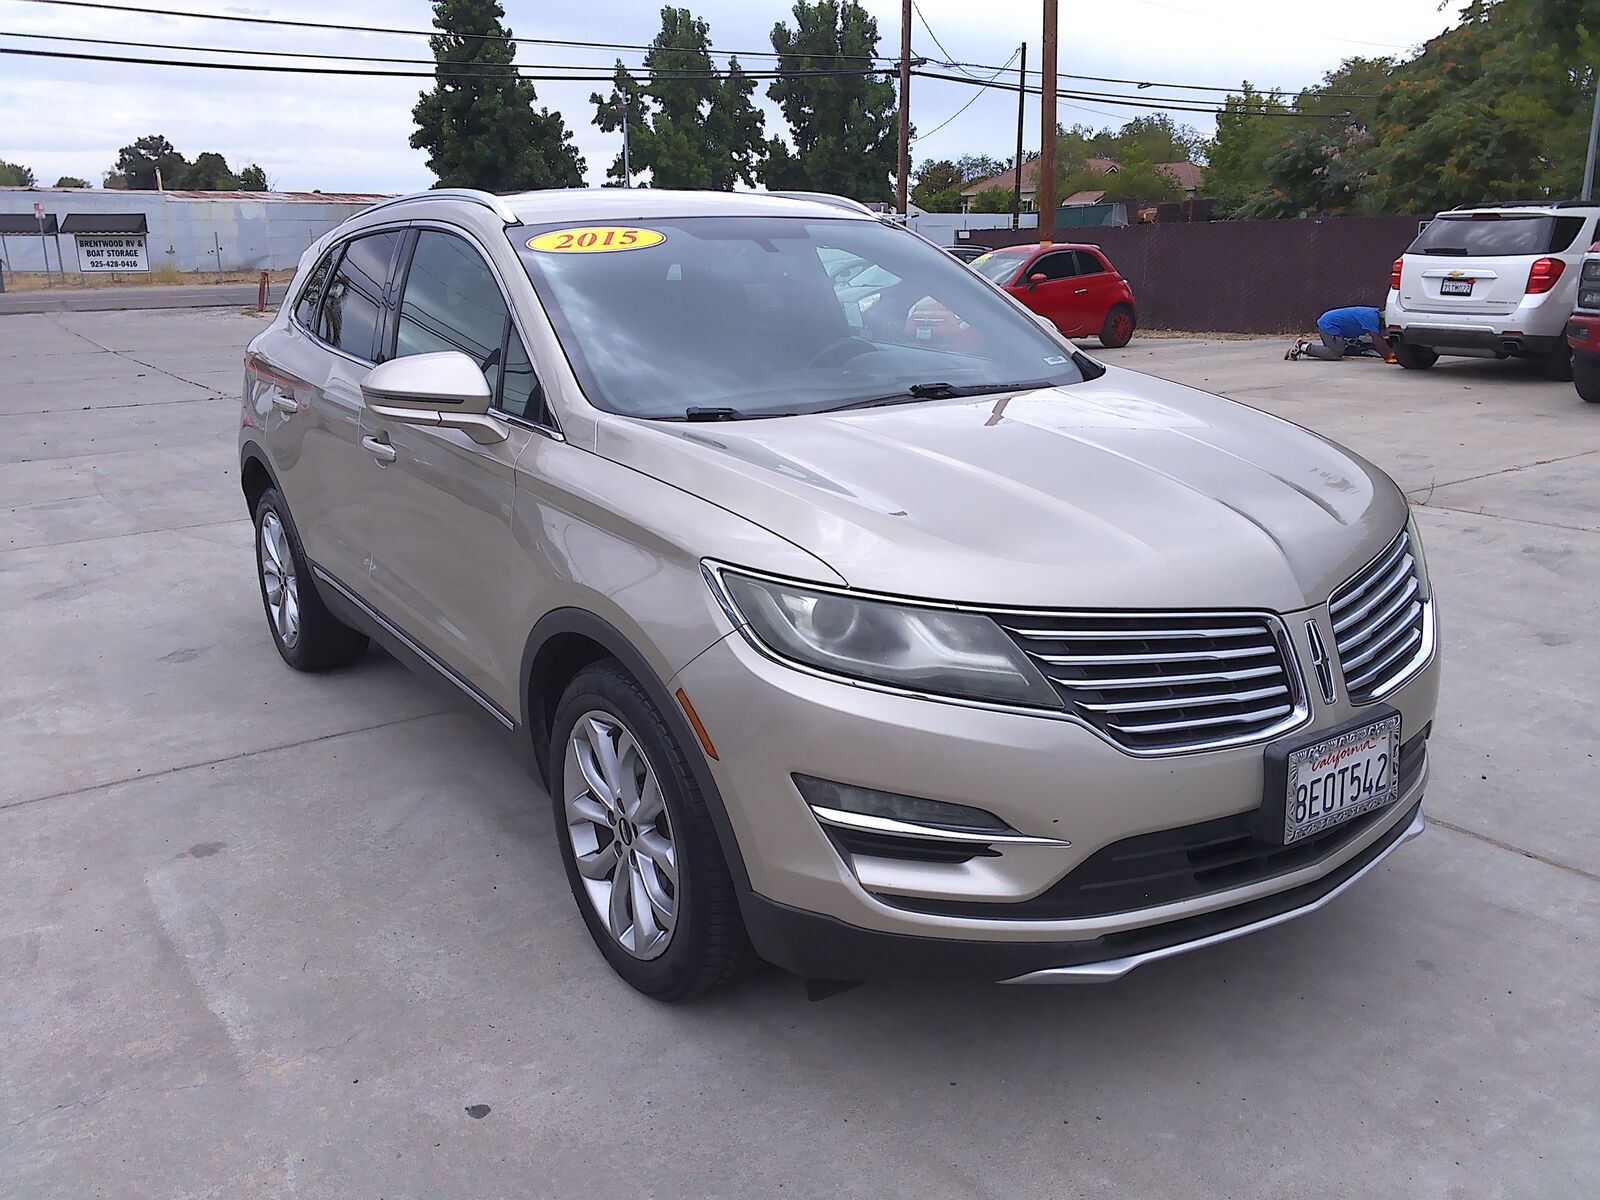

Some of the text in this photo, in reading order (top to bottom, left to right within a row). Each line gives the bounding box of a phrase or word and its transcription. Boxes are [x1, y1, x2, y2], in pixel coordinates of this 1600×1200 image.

[79, 239, 143, 248] BRENTWOOD RV &
[554, 230, 638, 250] 2015
[86, 249, 139, 258] BOAT STORAGE
[90, 260, 138, 268] 925-428-0416
